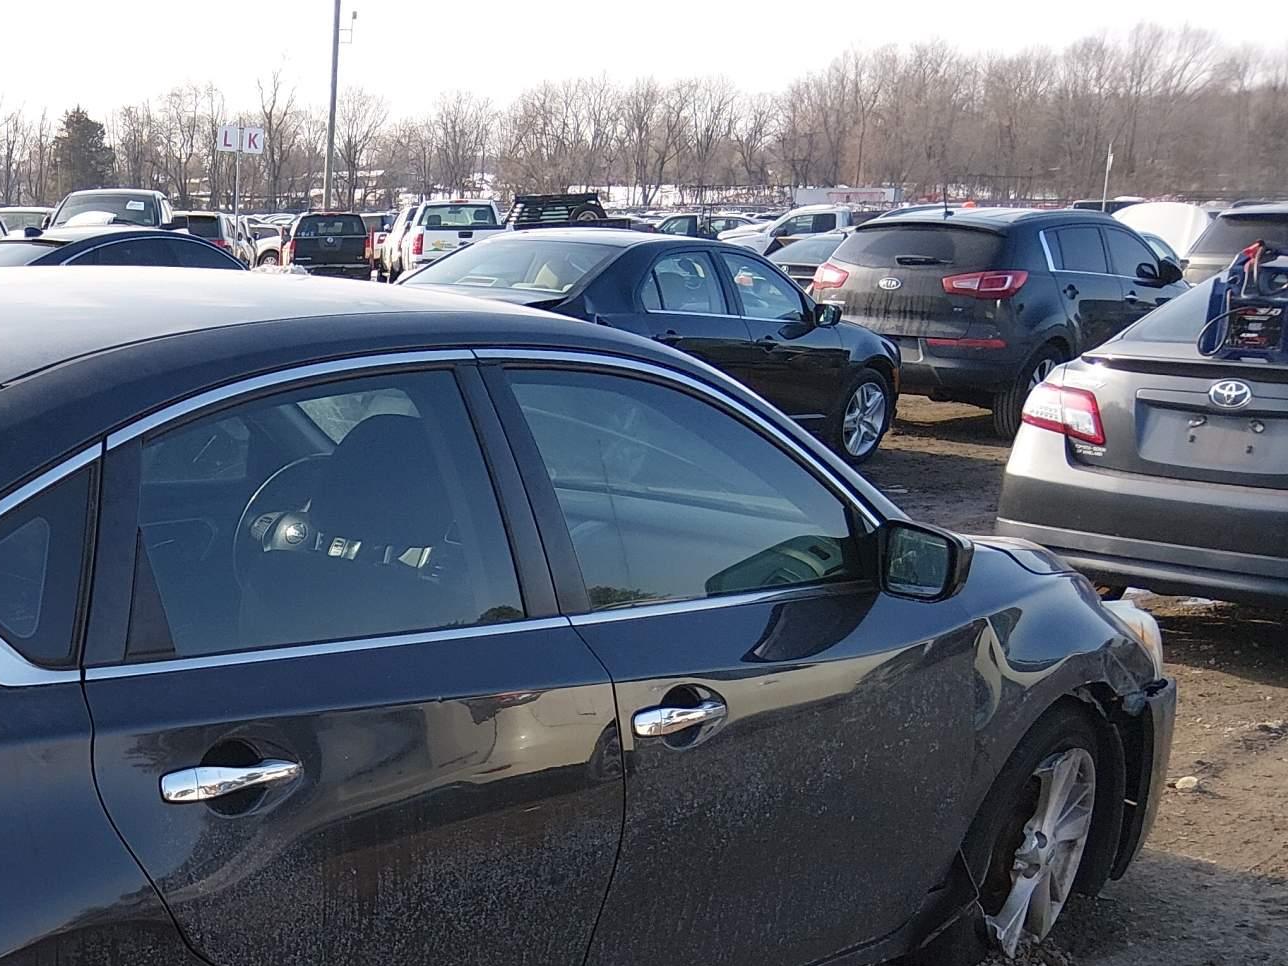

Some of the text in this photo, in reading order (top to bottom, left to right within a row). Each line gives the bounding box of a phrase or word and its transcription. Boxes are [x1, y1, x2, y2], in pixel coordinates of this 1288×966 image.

[223, 130, 232, 147] L
[248, 132, 258, 149] K
[880, 279, 899, 289] KIA
